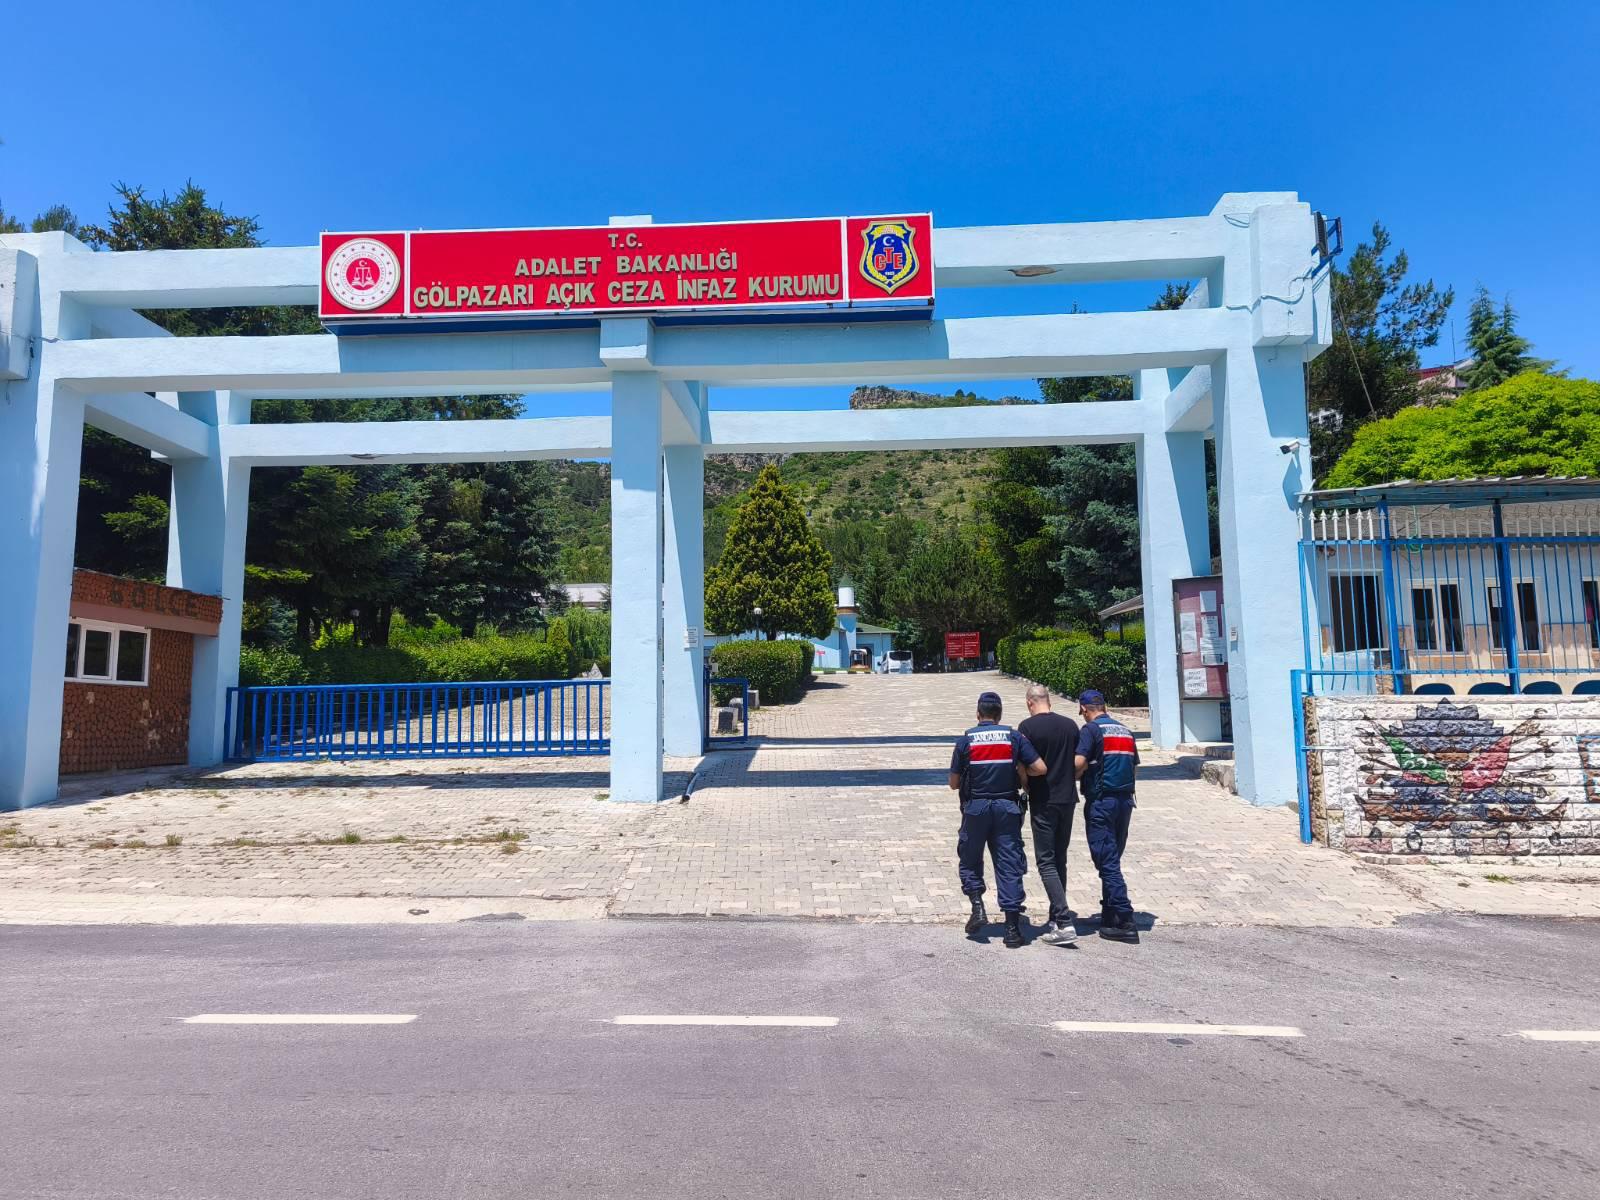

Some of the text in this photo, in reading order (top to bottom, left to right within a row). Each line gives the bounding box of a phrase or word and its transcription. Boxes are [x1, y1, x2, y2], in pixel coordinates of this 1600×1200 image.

[608, 233, 643, 248] T.C.
[515, 248, 738, 276] ADALET BAKANLIĞI
[413, 273, 840, 309] GÖLPAZARI AÇIK CEZA İNFAZ KURUMU
[972, 732, 1008, 743] JANDARMA
